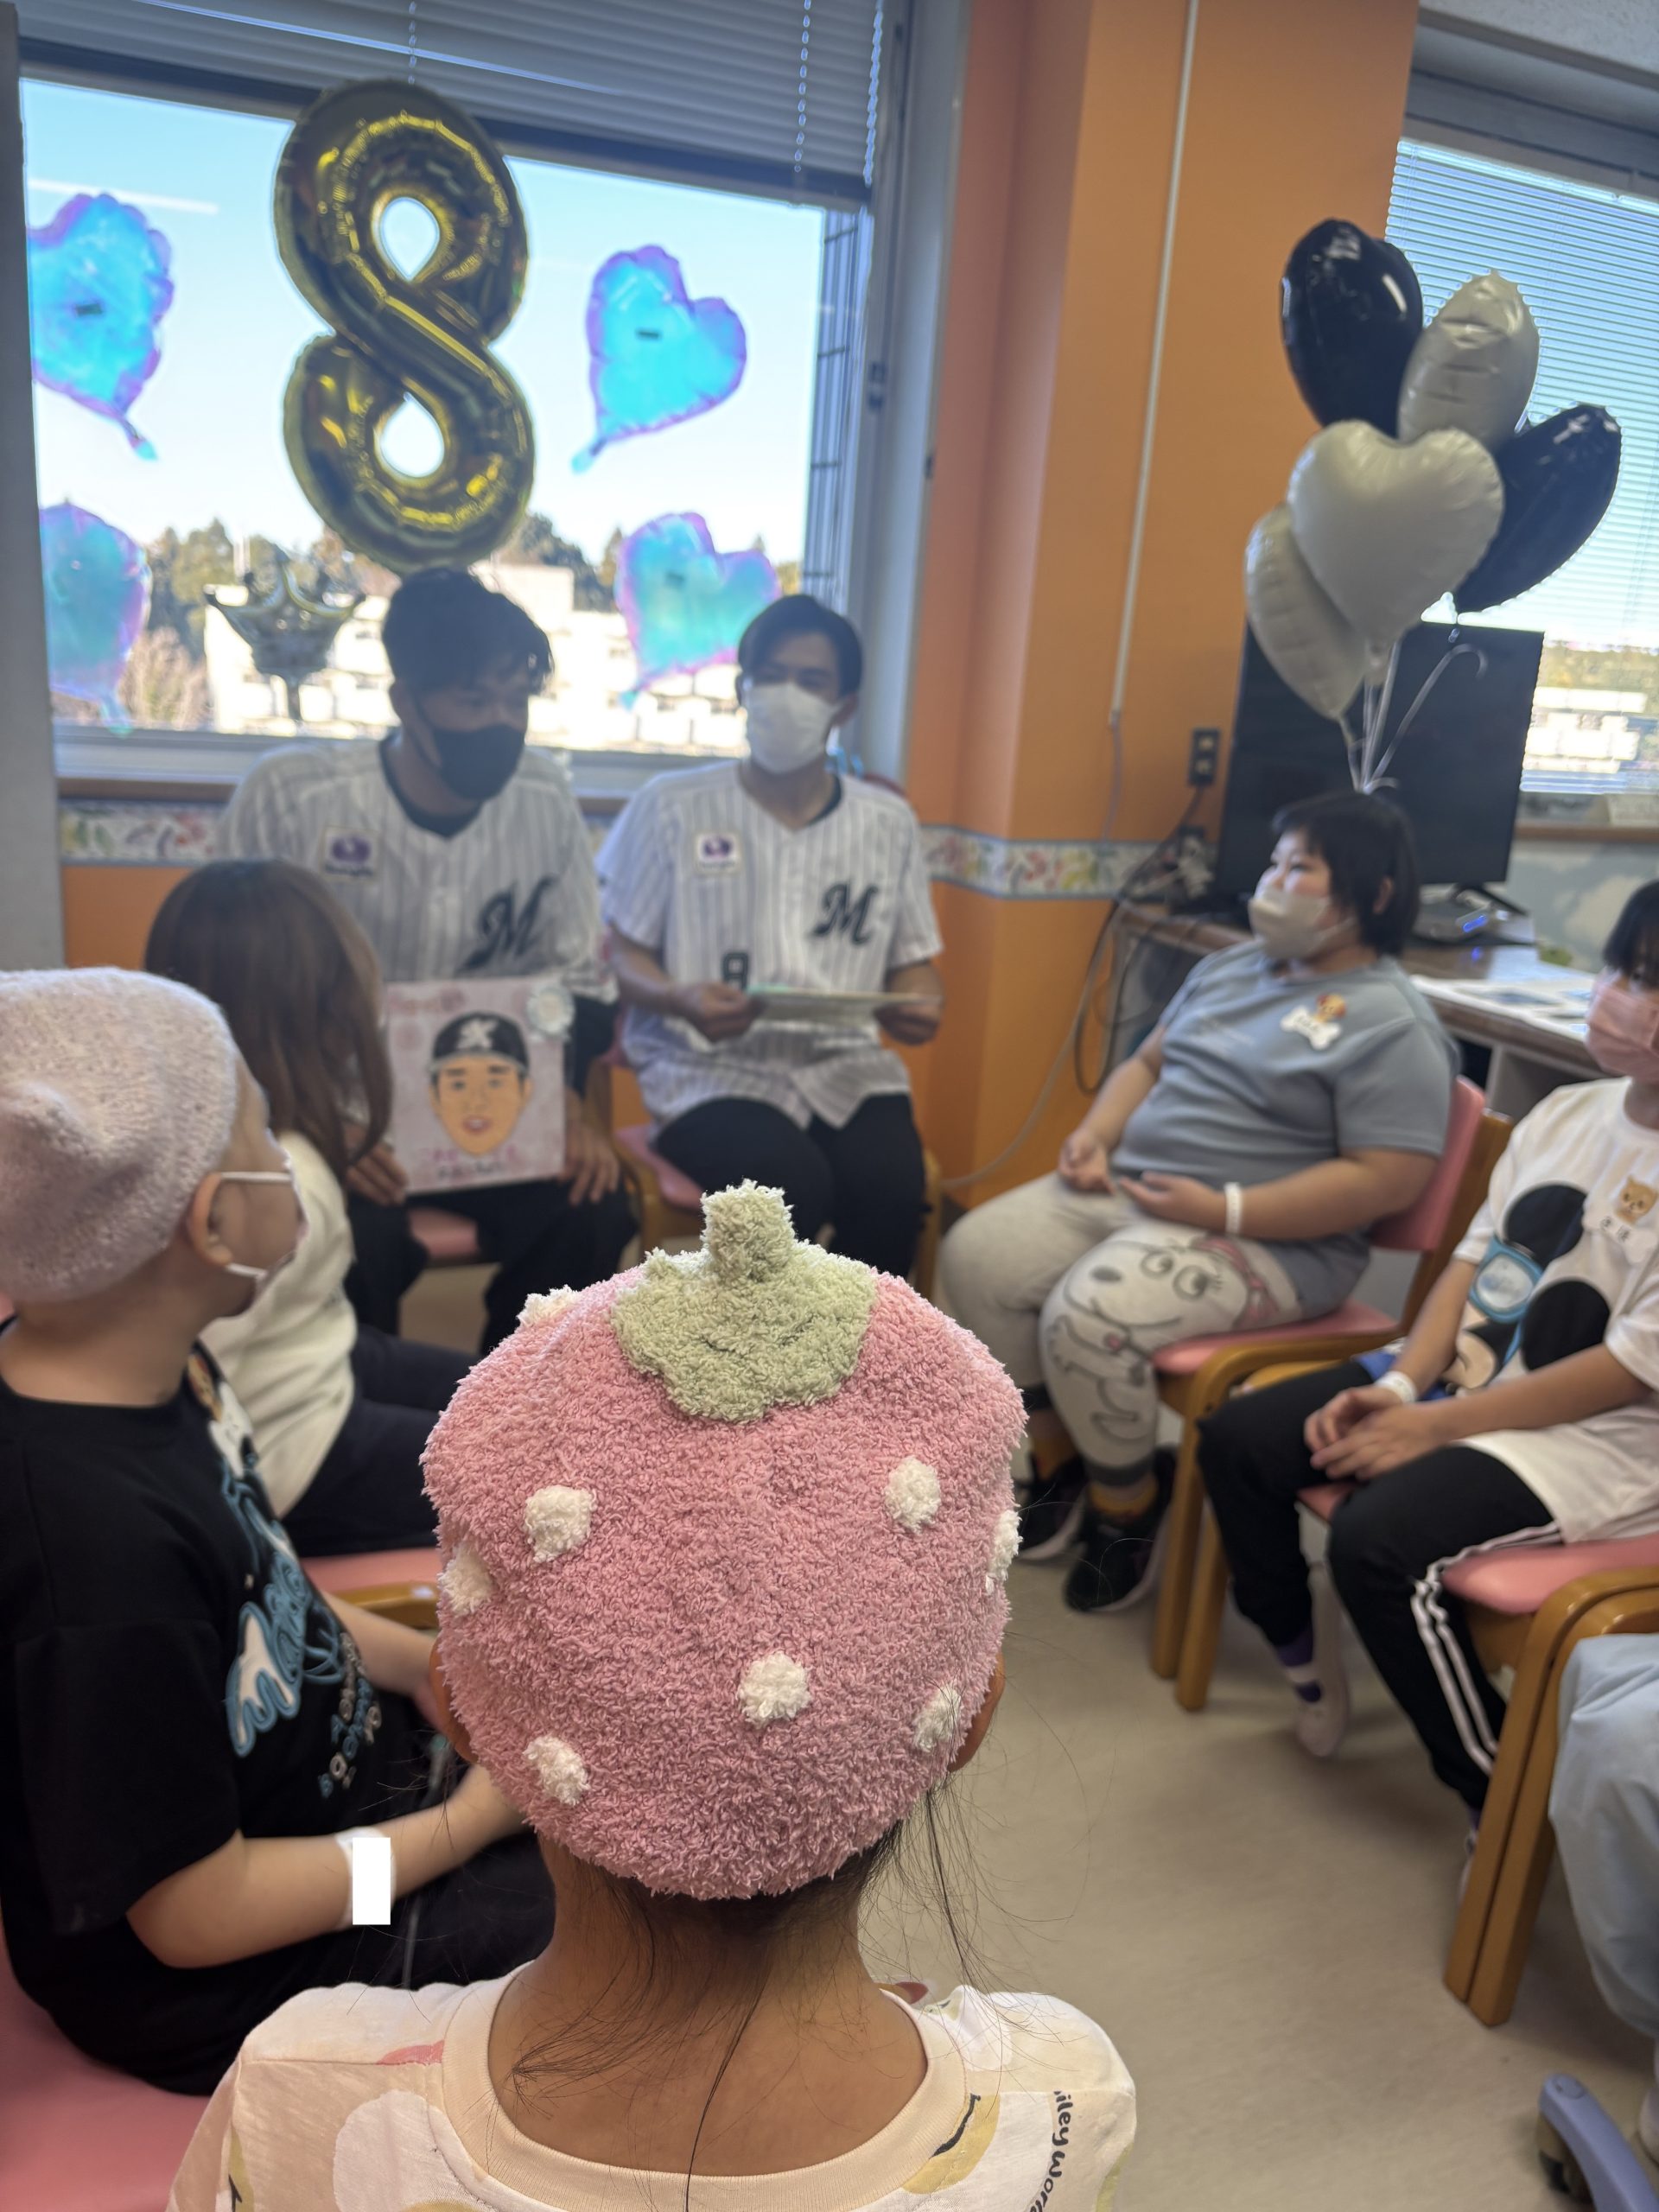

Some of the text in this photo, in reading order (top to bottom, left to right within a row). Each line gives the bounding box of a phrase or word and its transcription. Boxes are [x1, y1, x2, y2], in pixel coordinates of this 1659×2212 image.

[272, 79, 536, 574] 8
[455, 874, 560, 977] M
[810, 876, 879, 945] M
